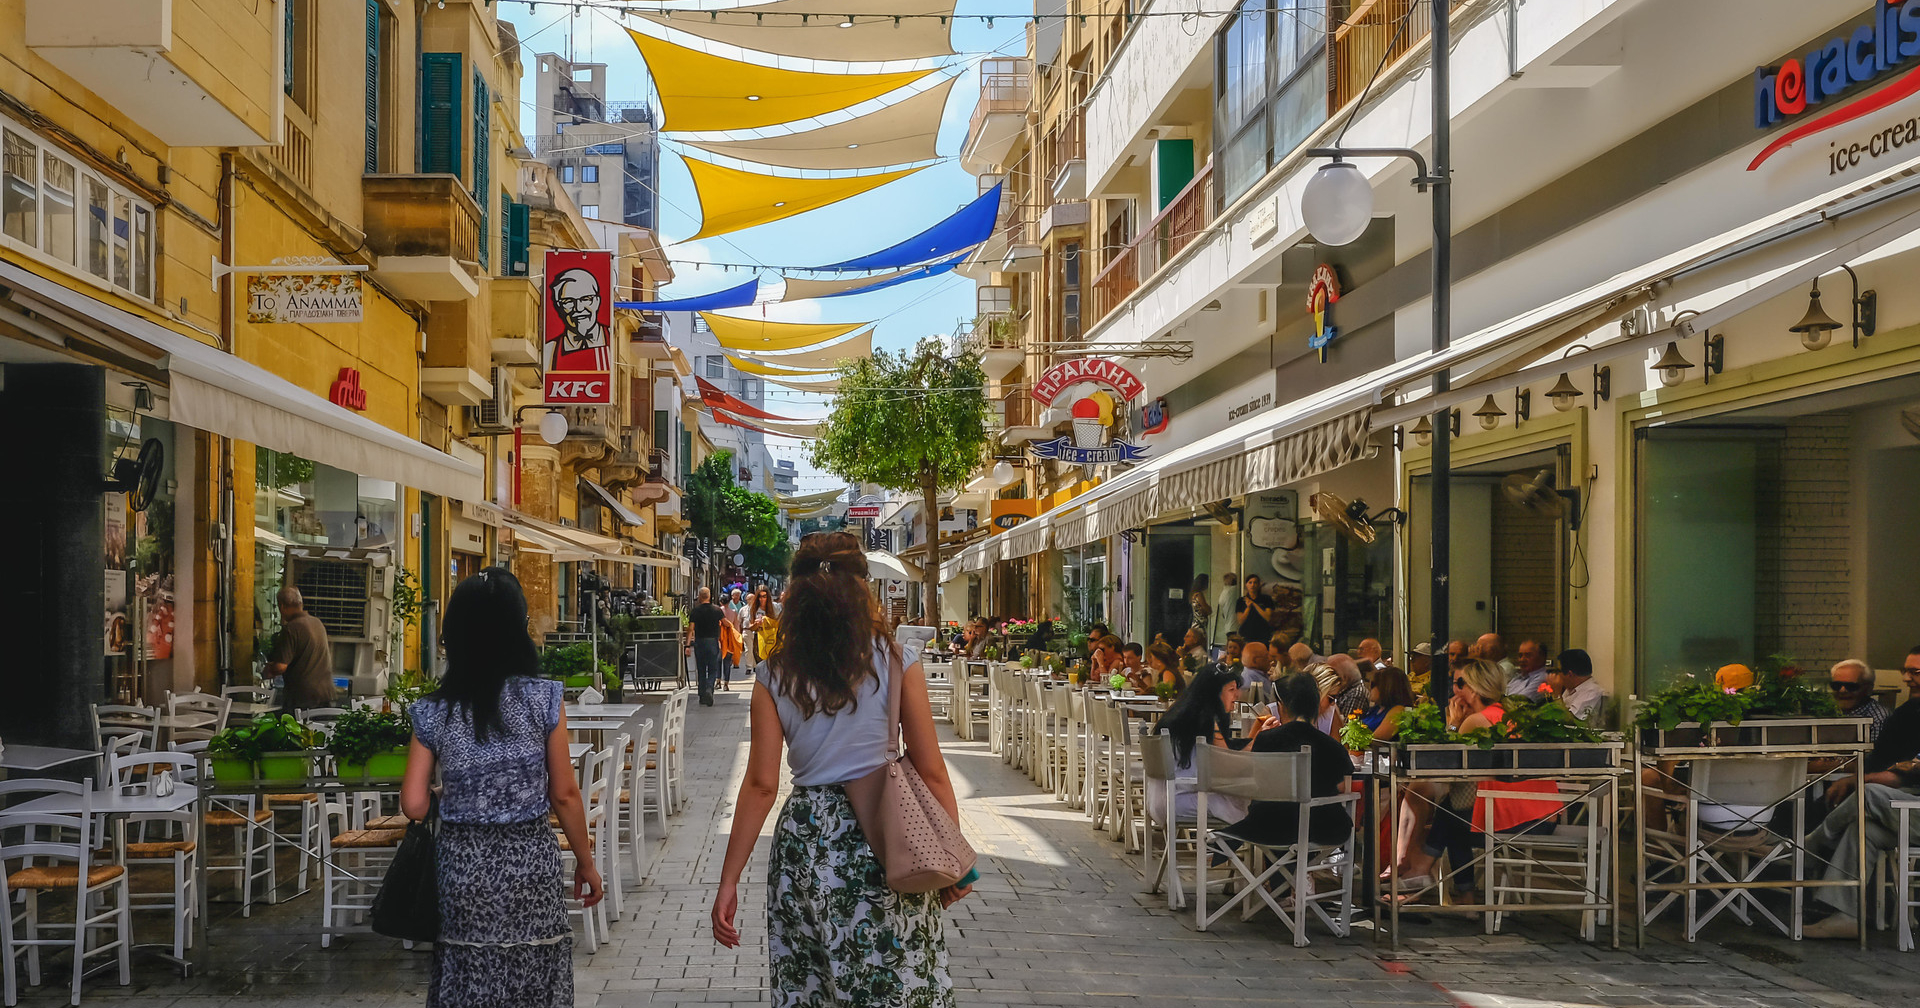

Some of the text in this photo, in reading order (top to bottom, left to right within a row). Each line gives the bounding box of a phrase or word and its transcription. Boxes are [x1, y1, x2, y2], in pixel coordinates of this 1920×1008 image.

[1829, 116, 1920, 176] ice-crea
[334, 367, 367, 411] Alba
[548, 381, 603, 398] KFC
[1037, 358, 1137, 400] ΗΡΑΚΛΗΣ
[1001, 516, 1027, 527] MTN
